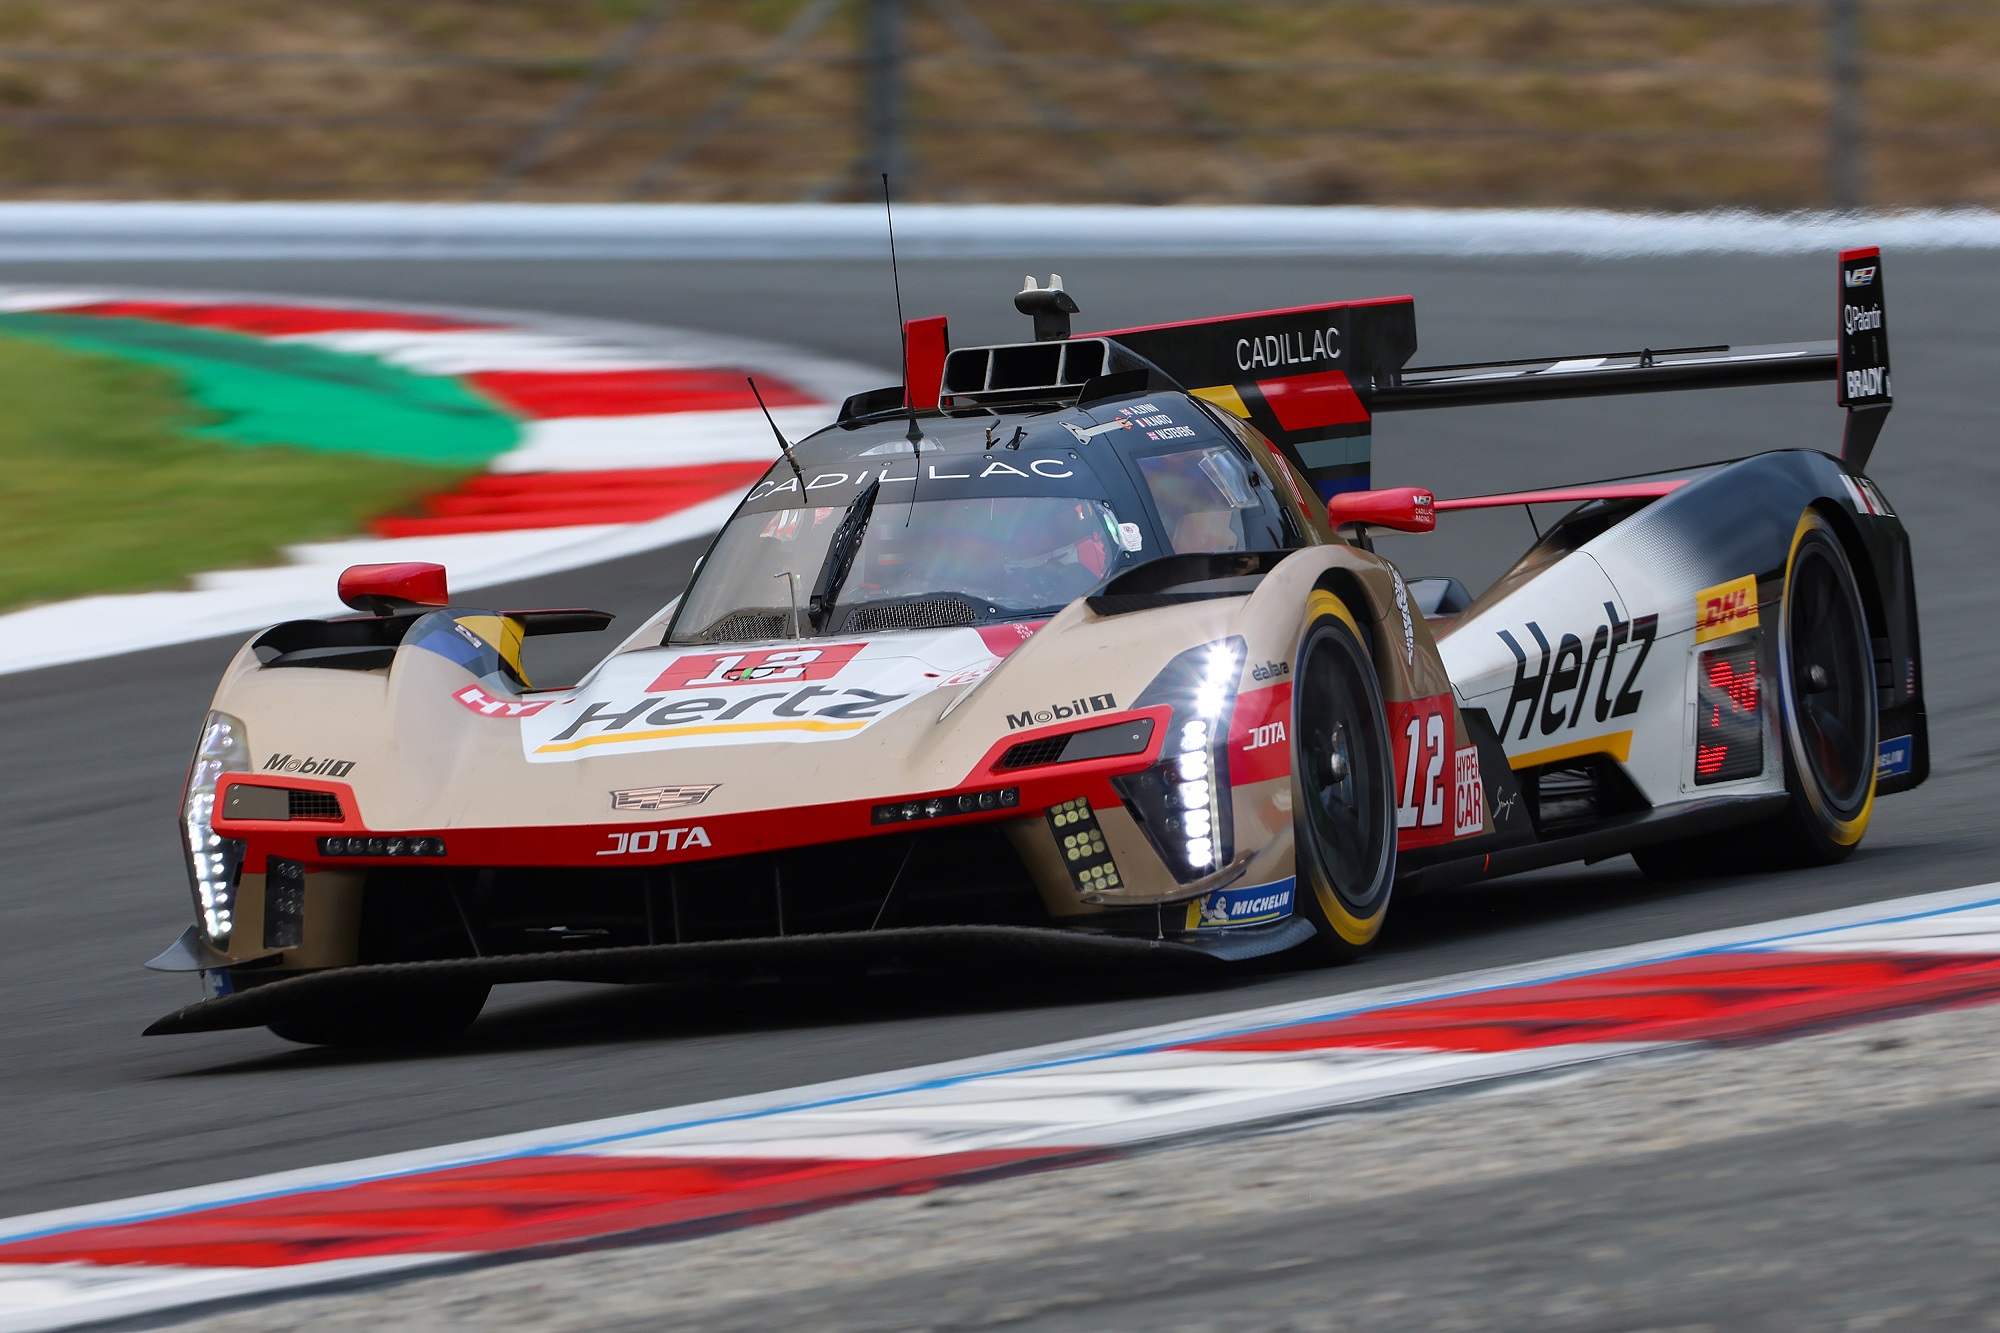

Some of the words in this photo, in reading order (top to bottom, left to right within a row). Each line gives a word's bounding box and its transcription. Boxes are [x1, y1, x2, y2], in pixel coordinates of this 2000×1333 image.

[1852, 303, 1882, 332] Palantir
[1236, 327, 1342, 371] CADILLAC
[1846, 367, 1884, 398] BRADY
[747, 459, 1074, 502] CADILLAC
[1705, 588, 1748, 628] DHL
[682, 650, 825, 688] 12
[1496, 600, 1659, 744] Hertz
[550, 684, 911, 742] Hertz
[1006, 698, 1089, 730] Mobil
[1242, 721, 1286, 751] JOTA
[262, 753, 335, 775] Mobil
[1397, 712, 1445, 831] 12
[1456, 781, 1482, 828] CAR
[596, 826, 712, 856] JOTA
[1231, 890, 1290, 916] MICHELIN
